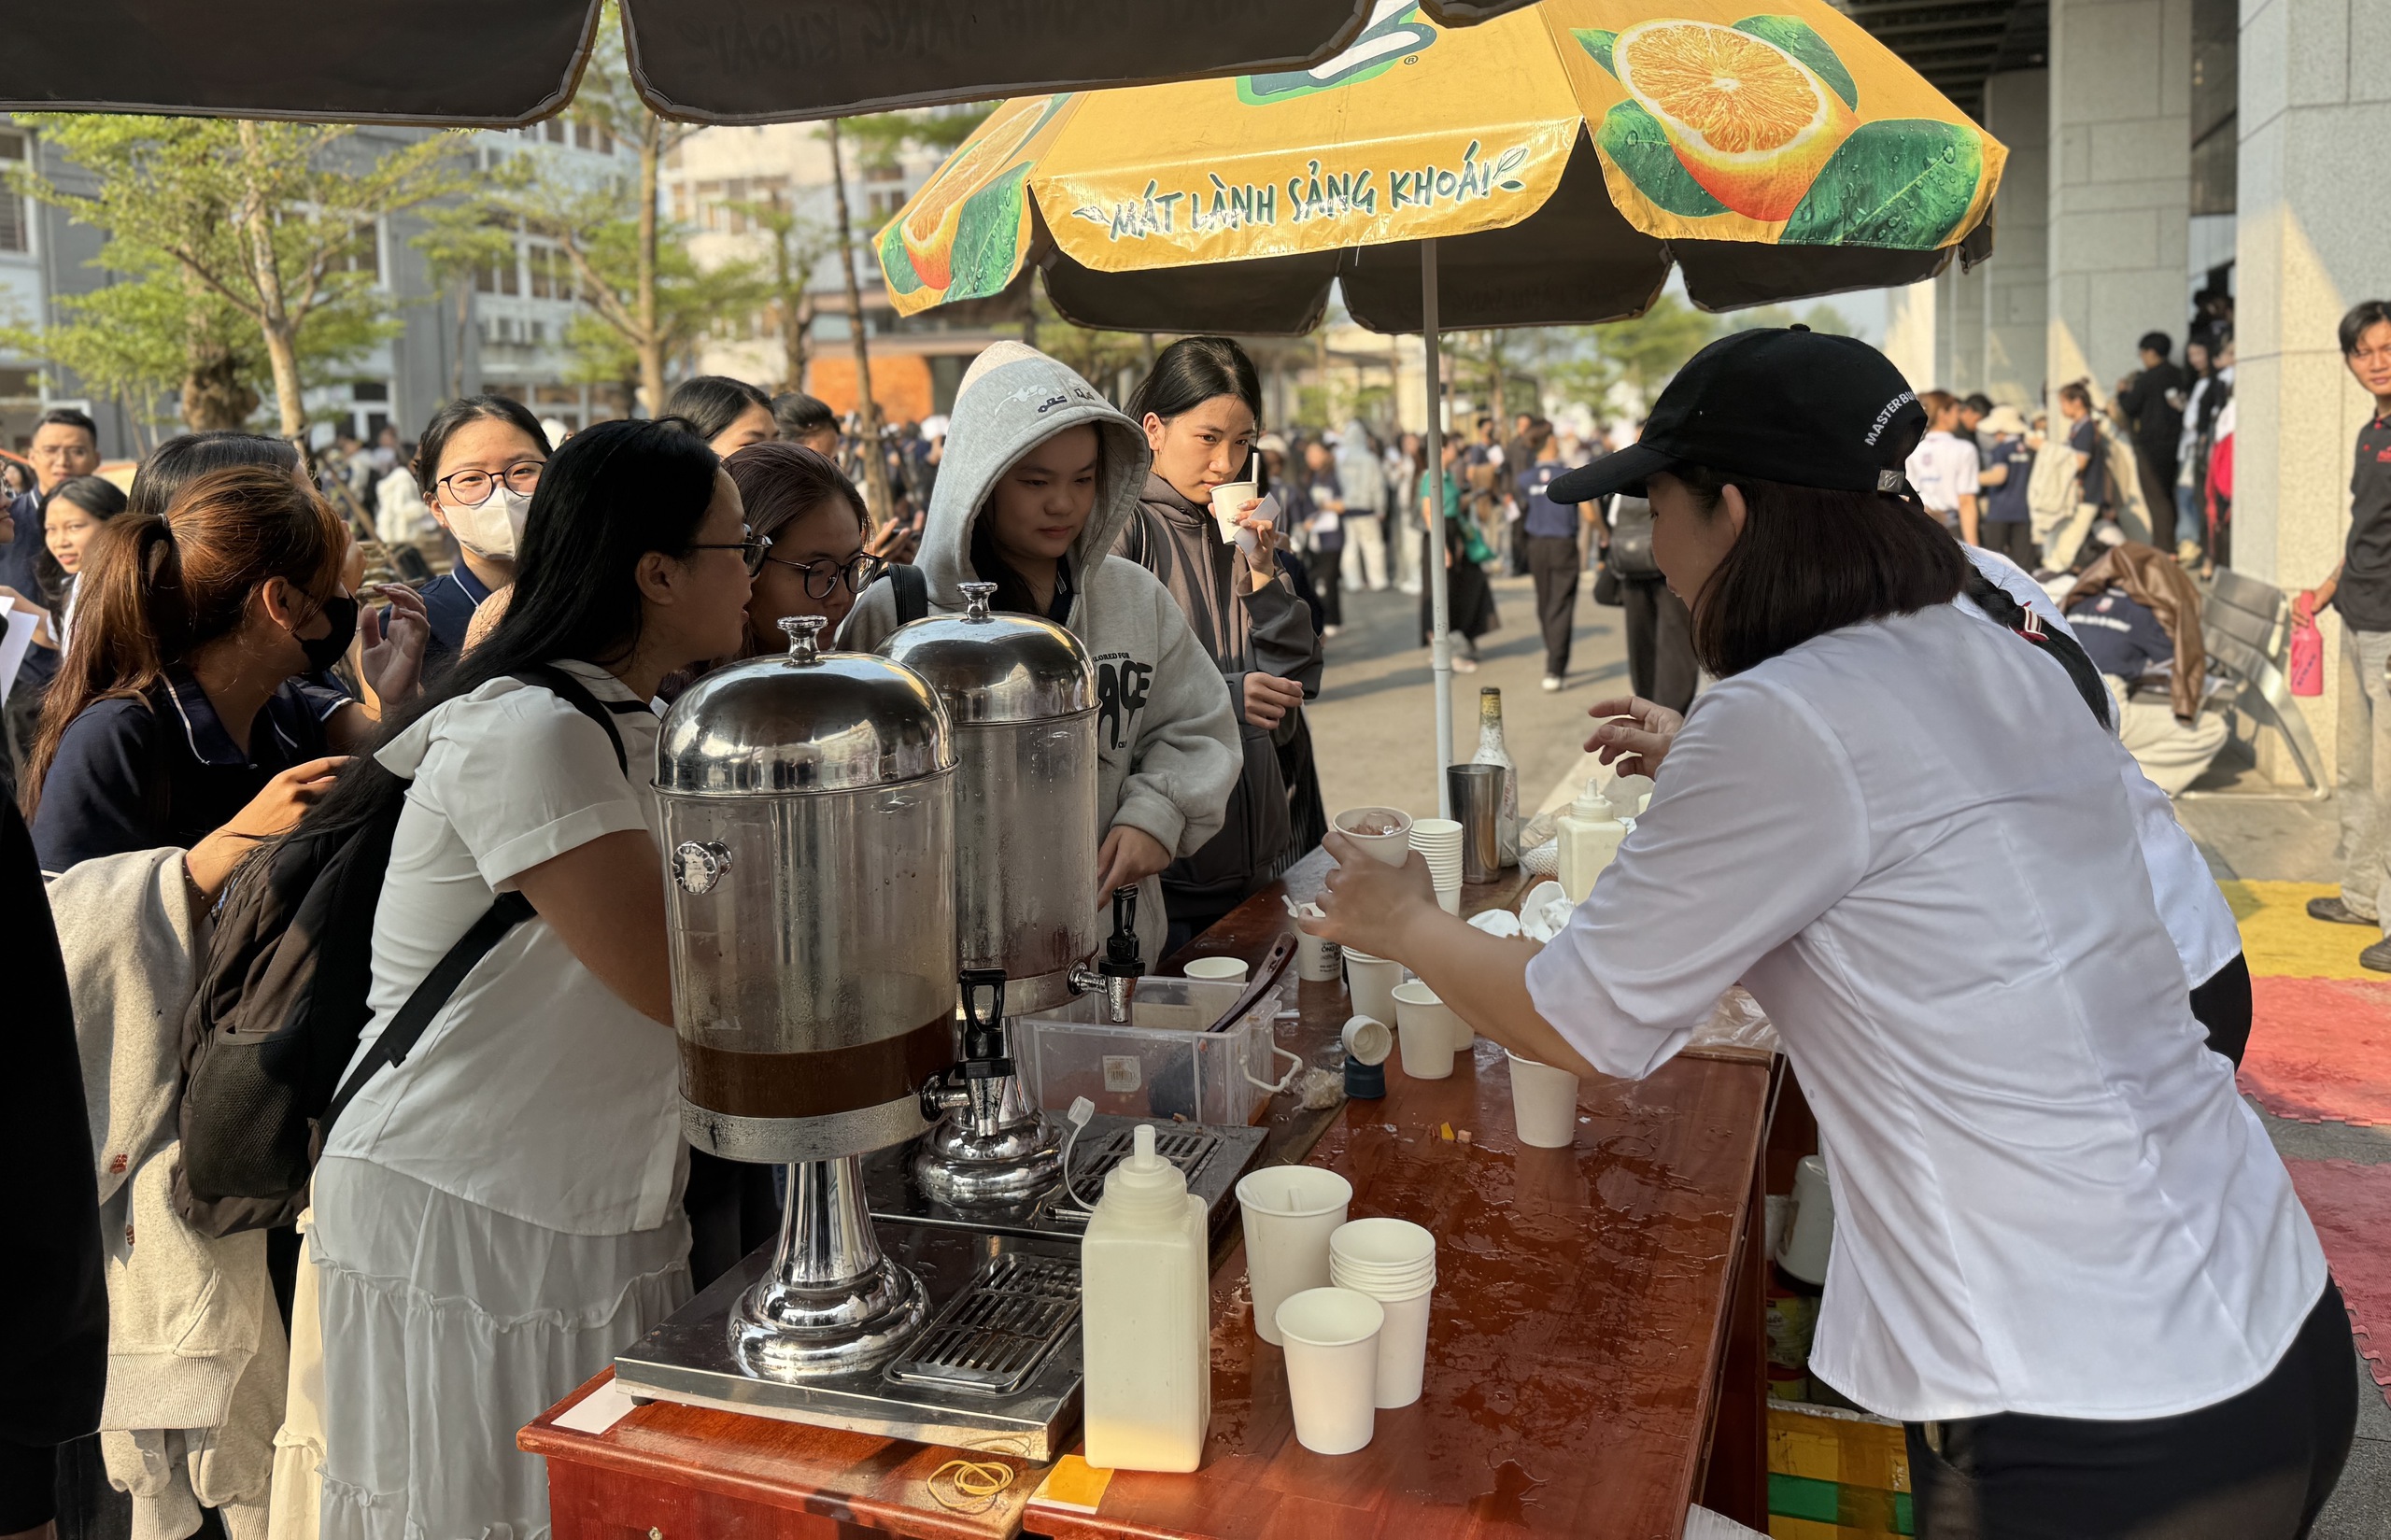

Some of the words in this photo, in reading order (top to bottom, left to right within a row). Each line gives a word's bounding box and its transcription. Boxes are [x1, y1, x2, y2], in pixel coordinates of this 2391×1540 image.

[1110, 179, 1184, 240] MÁT
[1191, 173, 1277, 231] LÀNH
[1288, 160, 1378, 223] SẢNG
[1389, 140, 1491, 210] KHOÁI
[1864, 398, 1903, 446] MASTER
[1092, 653, 1117, 663] ILORED
[1097, 659, 1153, 750] ACE
